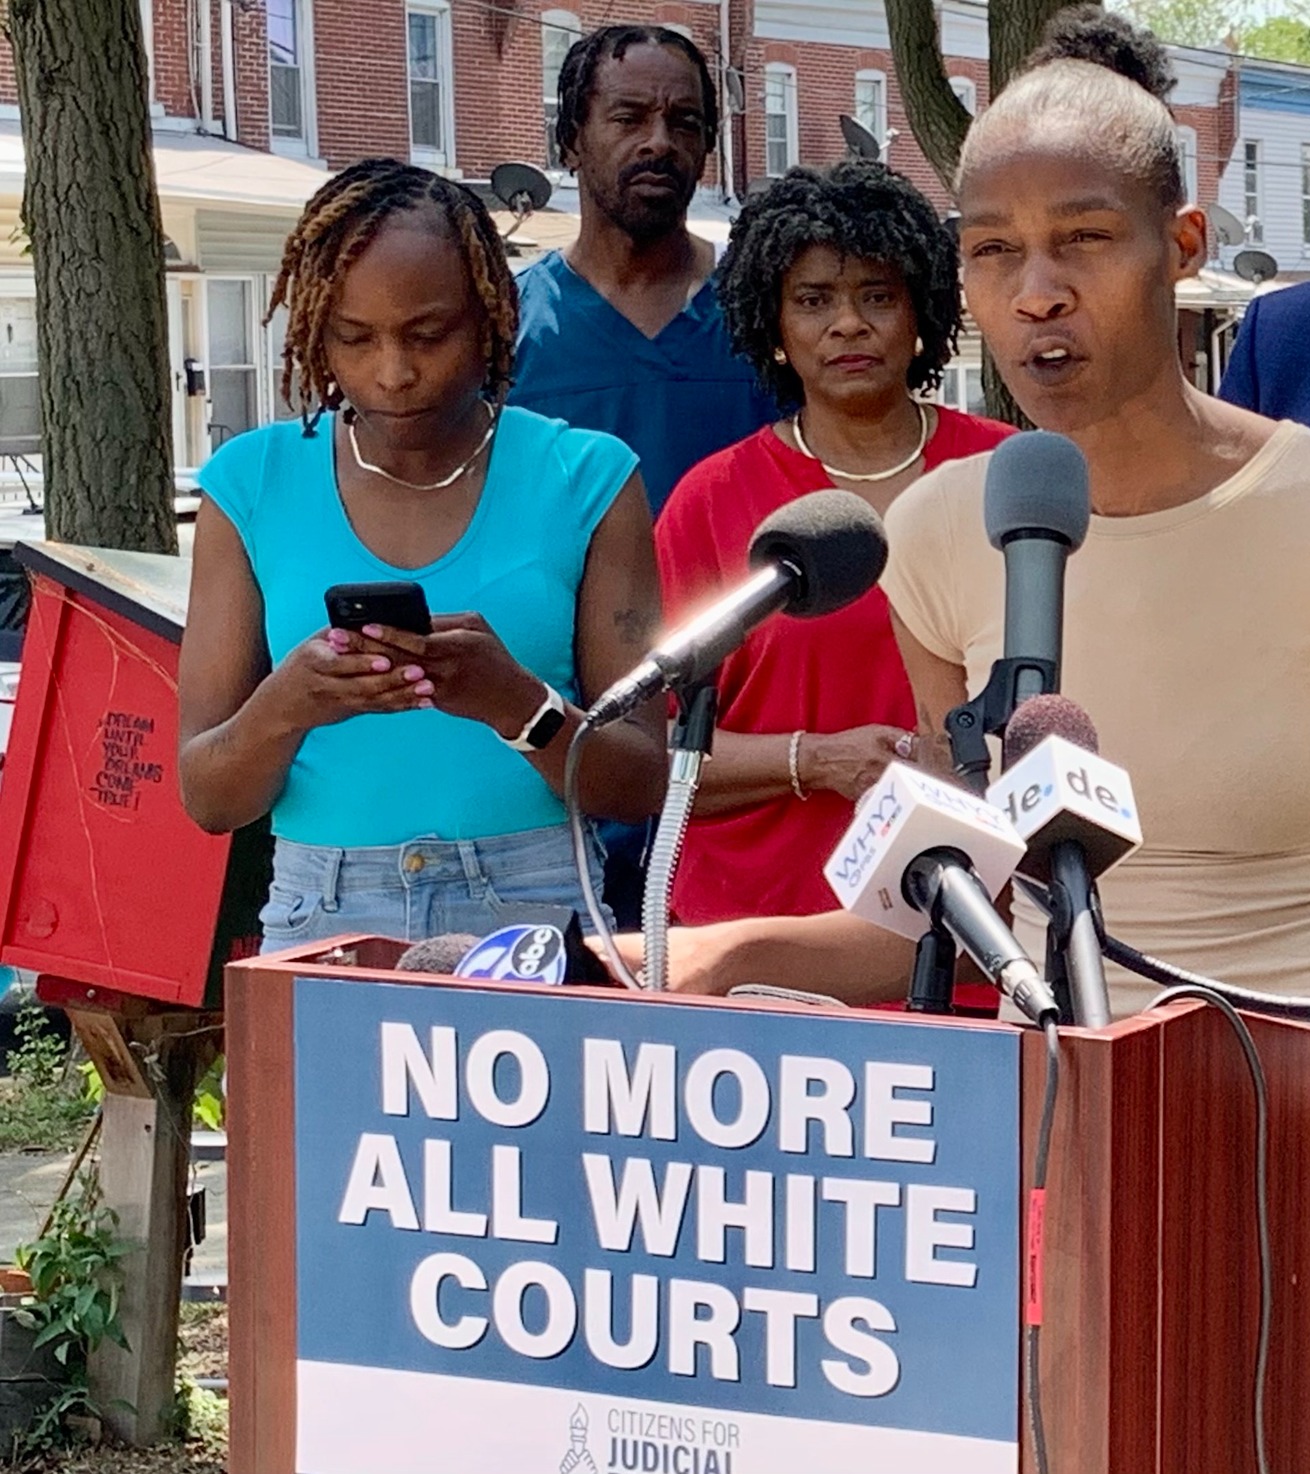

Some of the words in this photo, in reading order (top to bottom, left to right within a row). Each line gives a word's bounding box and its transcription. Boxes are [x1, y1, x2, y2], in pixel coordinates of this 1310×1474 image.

[835, 781, 897, 880] WHYY
[518, 928, 553, 976] abc
[381, 1020, 551, 1129] NO
[582, 1037, 938, 1166] MORE
[338, 1132, 560, 1245] ALL
[583, 1152, 979, 1288] WHITE
[409, 1251, 902, 1398] COURTS
[607, 1408, 696, 1443] CITIZENS
[701, 1419, 741, 1449] FOR
